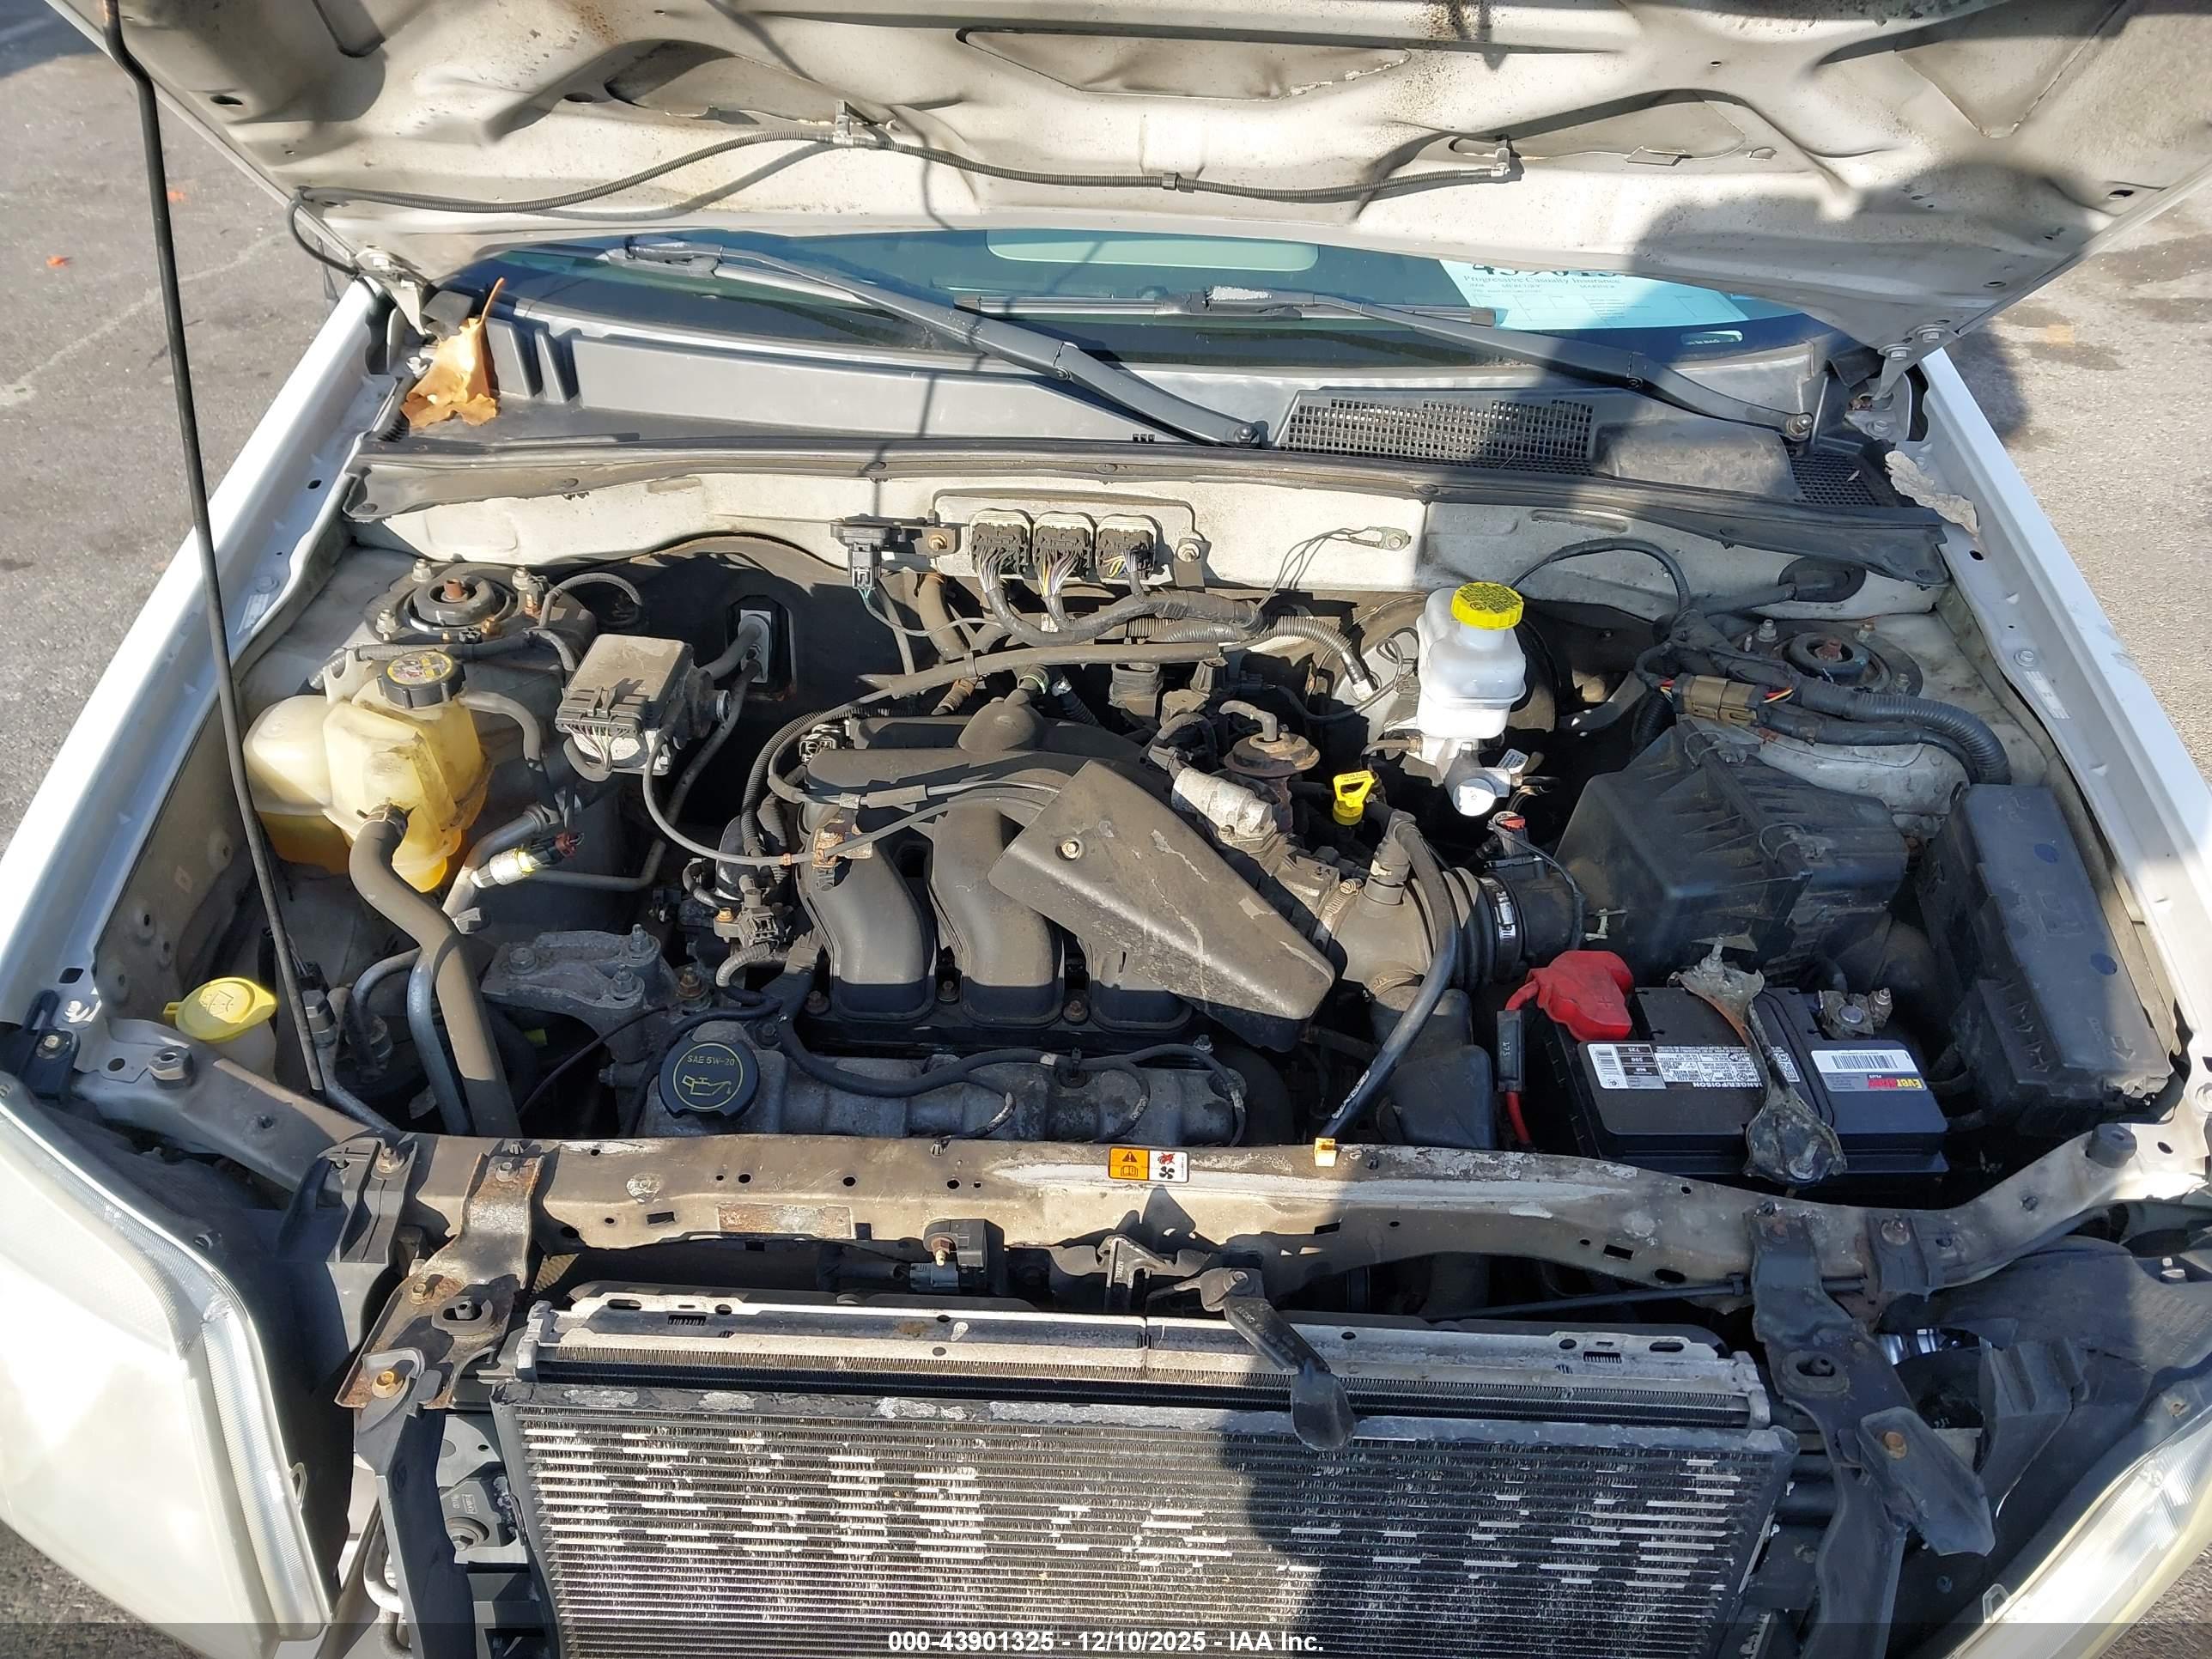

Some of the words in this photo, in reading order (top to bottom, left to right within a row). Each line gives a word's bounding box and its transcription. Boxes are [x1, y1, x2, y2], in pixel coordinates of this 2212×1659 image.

[1463, 275, 1524, 284] Progressive
[1525, 276, 1569, 284] Casualty
[687, 1054, 704, 1064] SAE
[706, 1056, 735, 1066] 5W-20
